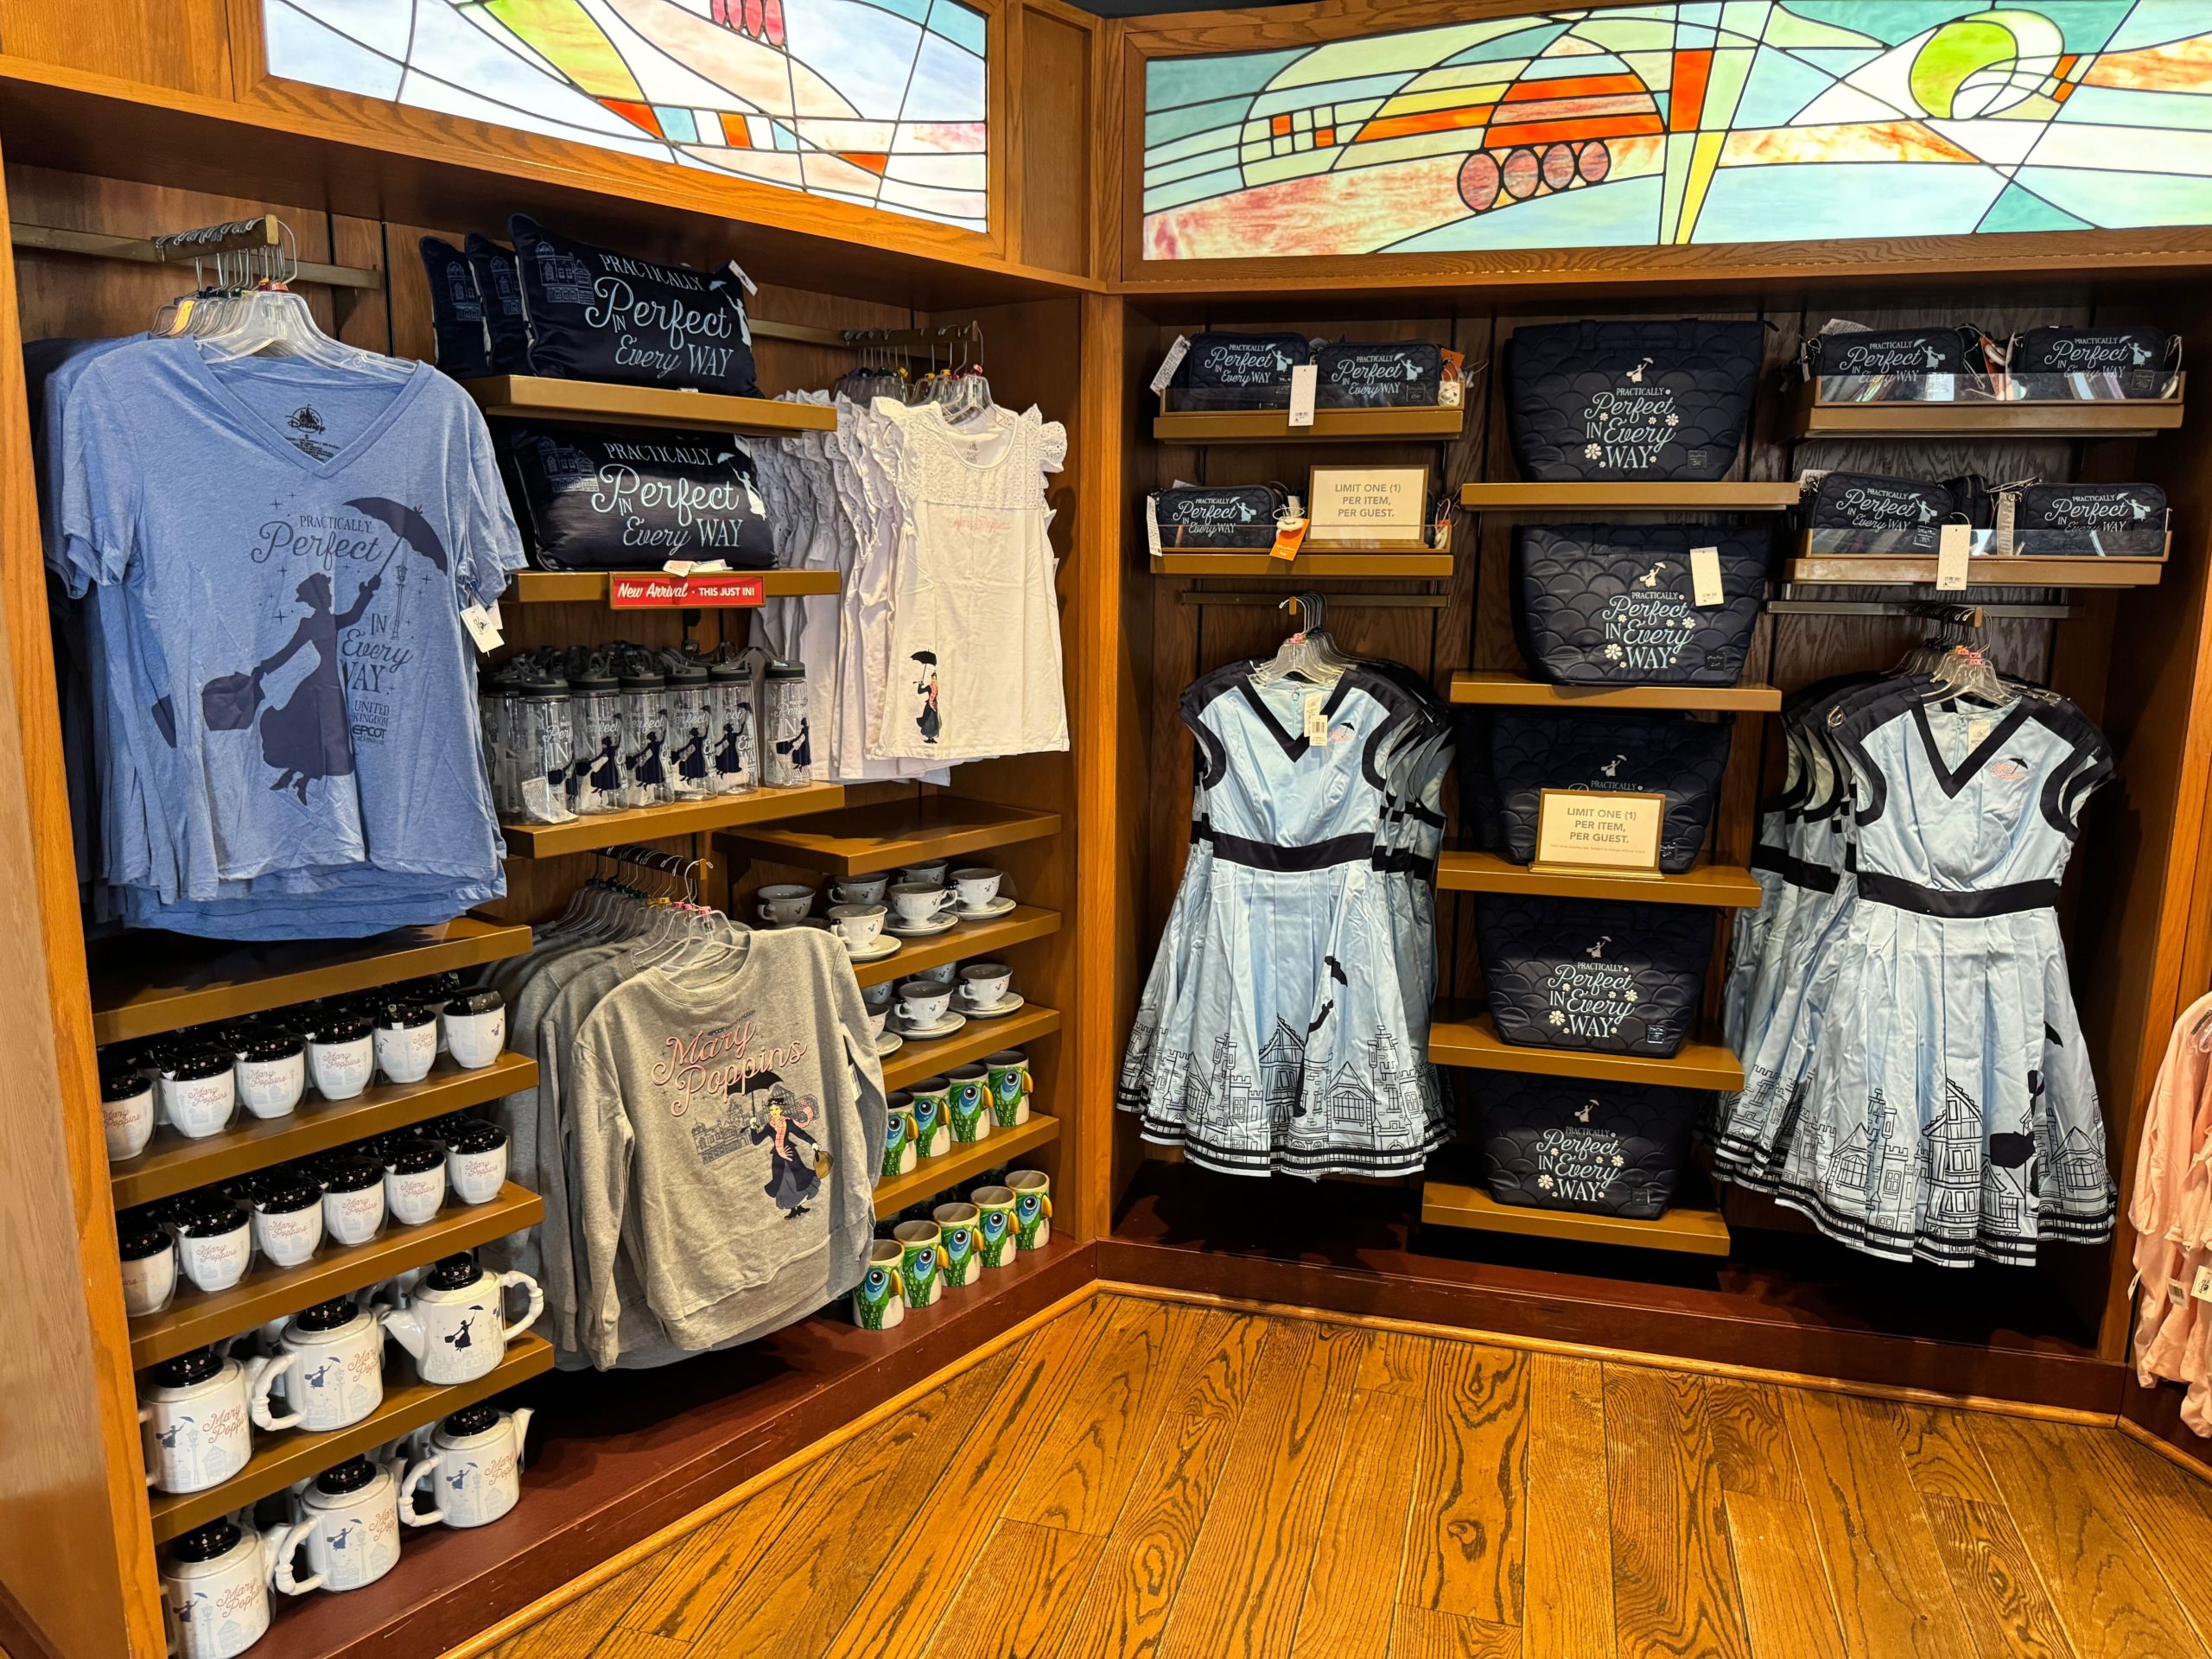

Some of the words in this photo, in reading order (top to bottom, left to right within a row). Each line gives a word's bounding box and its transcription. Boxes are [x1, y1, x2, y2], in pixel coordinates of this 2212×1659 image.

[599, 253, 705, 292] PRACTICALLY
[585, 276, 732, 350] Perfect
[613, 315, 626, 334] IN
[1229, 344, 1265, 353] PRACTICALLY
[1869, 340, 1913, 349] PRACTICALLY
[615, 334, 681, 379] Every
[688, 344, 734, 378] WAY
[1205, 346, 1273, 376] Perfect
[1840, 346, 1922, 375] Perfect
[2044, 340, 2128, 372] Perfect
[1215, 364, 1222, 372] IN
[1852, 365, 1861, 374] IN
[2057, 359, 2066, 369] IN
[1221, 369, 1251, 387] Every
[1251, 372, 1271, 384] WAY
[1332, 357, 1402, 388] Perfect
[1859, 372, 1897, 386] Every
[1897, 370, 1919, 382] WAY
[2064, 364, 2102, 382] Every
[2102, 365, 2126, 378] WAY
[1342, 378, 1350, 386] IN
[1349, 382, 1381, 397] Every
[1381, 381, 1401, 394] WAY
[1616, 387, 1664, 397] PRACTICALLY
[1584, 391, 1675, 423] Perfect
[1586, 421, 1602, 439] IN
[1604, 418, 1676, 452] Every
[603, 442, 714, 466] PRACTICALLY
[1605, 445, 1652, 469] WAY
[592, 464, 739, 526] Perfect
[1334, 483, 1362, 493] LIMIT
[1364, 484, 1387, 493] ONE
[1389, 483, 1402, 493] (1)
[1867, 488, 1907, 499] PRACTICALLY
[619, 497, 632, 516] IN
[1342, 496, 1362, 505] PER
[1364, 496, 1392, 506] ITEM,
[1836, 489, 1916, 524] Perfect
[1173, 499, 1237, 527] Perfect
[1338, 508, 1357, 518] PER
[1359, 508, 1395, 518] GUEST.
[1847, 506, 1856, 517] IN
[2044, 498, 2128, 527] Perfect
[300, 515, 372, 533] PRACTICALLY
[1853, 514, 1886, 531] Every
[1886, 518, 1910, 532] WAY
[2057, 517, 2067, 525] IN
[2064, 522, 2102, 534] Every
[2102, 521, 2126, 532] WAY
[623, 516, 690, 556] Every
[696, 518, 744, 547] WAY
[1188, 522, 1217, 537] Every
[1217, 523, 1236, 533] WAY
[251, 520, 382, 571] Perfect
[618, 582, 644, 599] New
[646, 582, 689, 599] Arrival
[698, 587, 719, 597] THIS
[720, 587, 739, 597] JUST
[741, 587, 755, 596] IN!
[1631, 591, 1679, 601] PRACTICALLY
[1602, 595, 1690, 626] Perfect
[371, 613, 388, 635] IN
[1605, 622, 1621, 640] IN
[1623, 620, 1694, 654] Every
[341, 628, 413, 673] Every
[1625, 646, 1671, 669] WAY
[354, 700, 389, 715] UNITED
[353, 713, 388, 727] KINGDOM
[352, 725, 387, 739] EPCOT
[1590, 779, 1637, 791] PRACTICALLY
[1567, 807, 1596, 817] LIMIT
[1598, 809, 1622, 819] ONE
[1624, 810, 1637, 821] (1)
[1574, 820, 1595, 830] PER
[1598, 821, 1626, 833] ITEM,
[1570, 832, 1589, 842] PER
[1592, 834, 1629, 844] GUEST.
[1577, 962, 1623, 972] PRACTICALLY
[1548, 963, 1635, 995] Perfect
[1549, 991, 1565, 1006] IN
[1567, 988, 1636, 1024] Every
[1568, 1014, 1614, 1038] WAY
[323, 1051, 352, 1062] Mary
[651, 1020, 758, 1086] Mary
[326, 1058, 361, 1069] Poppins
[247, 1070, 276, 1079] Mary
[251, 1076, 287, 1088] Poppins
[671, 1039, 808, 1117] Poppins
[188, 1085, 218, 1098] Mary
[193, 1091, 227, 1106] Poppins
[103, 1109, 130, 1121] Mary
[105, 1114, 140, 1128] Poppins
[1566, 1126, 1610, 1137] PRACTICALLY
[1536, 1128, 1622, 1161] Perfect
[465, 1161, 490, 1171] Mary
[468, 1166, 497, 1176] Poppins
[1538, 1155, 1554, 1171] IN
[1554, 1153, 1622, 1189] Every
[401, 1182, 427, 1191] Mary
[404, 1186, 435, 1197] Poppins
[1557, 1179, 1601, 1202] WAY
[342, 1198, 369, 1208] Mary
[346, 1203, 377, 1216] Poppins
[270, 1221, 296, 1230] Mary
[272, 1227, 307, 1238] Poppins
[196, 1245, 226, 1255] Mary
[200, 1249, 238, 1263] Poppins
[347, 1349, 377, 1371] Mary
[203, 1404, 241, 1432] Mary
[485, 1452, 513, 1475] Mary
[216, 1577, 257, 1606] Mary
